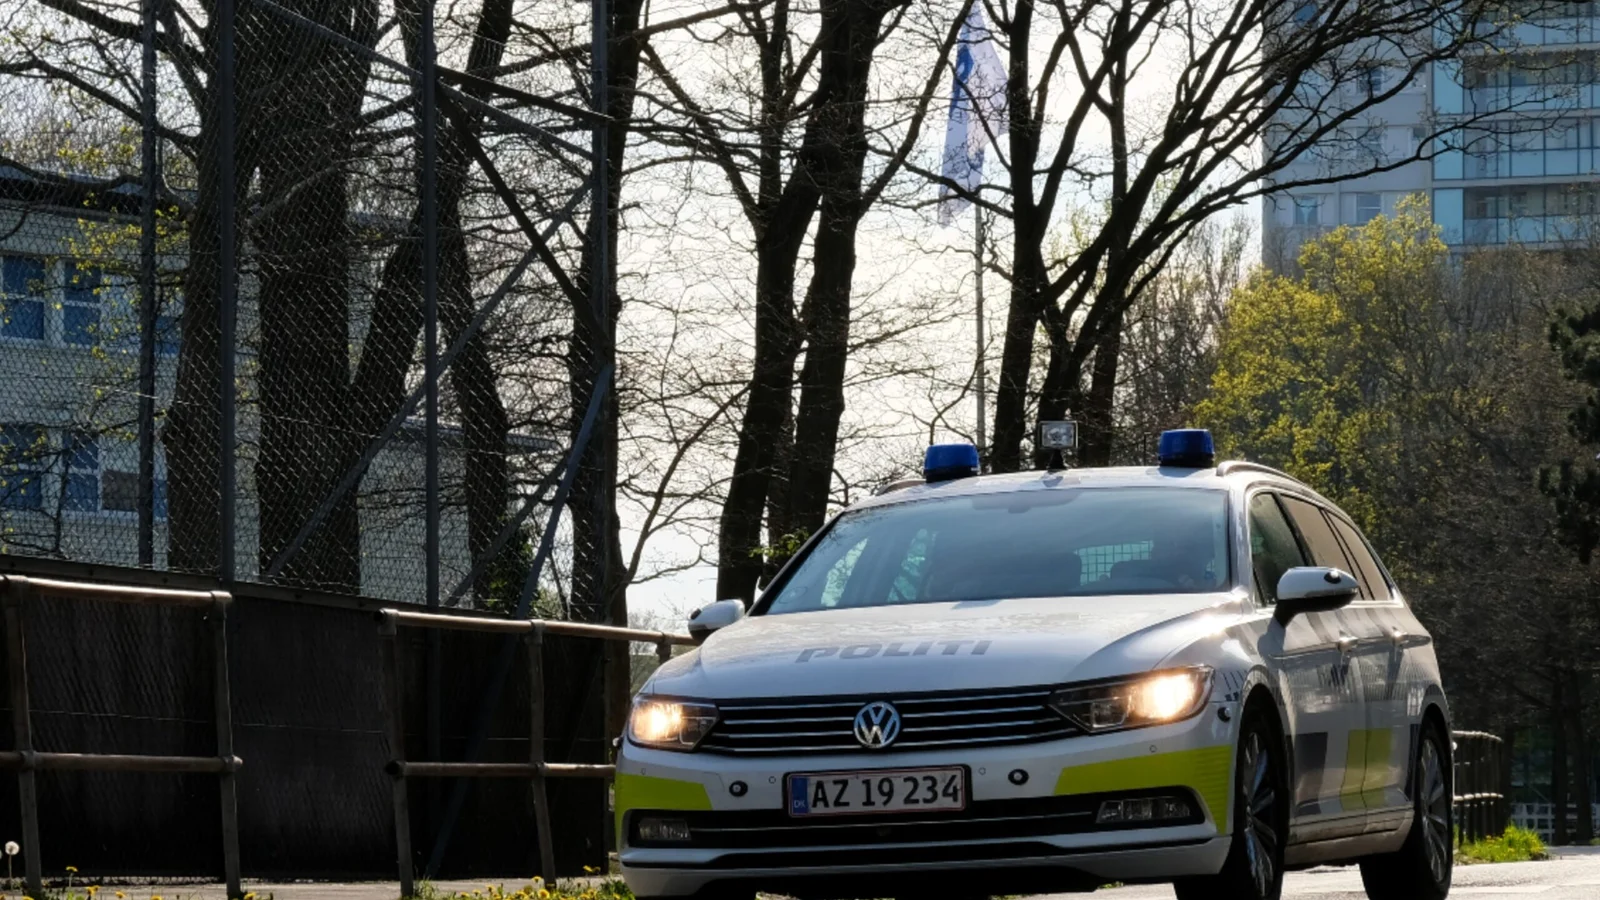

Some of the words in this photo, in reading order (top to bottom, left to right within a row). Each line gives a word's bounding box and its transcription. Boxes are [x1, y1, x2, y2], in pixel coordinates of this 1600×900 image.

[795, 640, 992, 663] POLITI
[855, 703, 899, 747] VW
[811, 779, 849, 808] AZ
[861, 777, 894, 807] 19
[903, 774, 958, 804] 234
